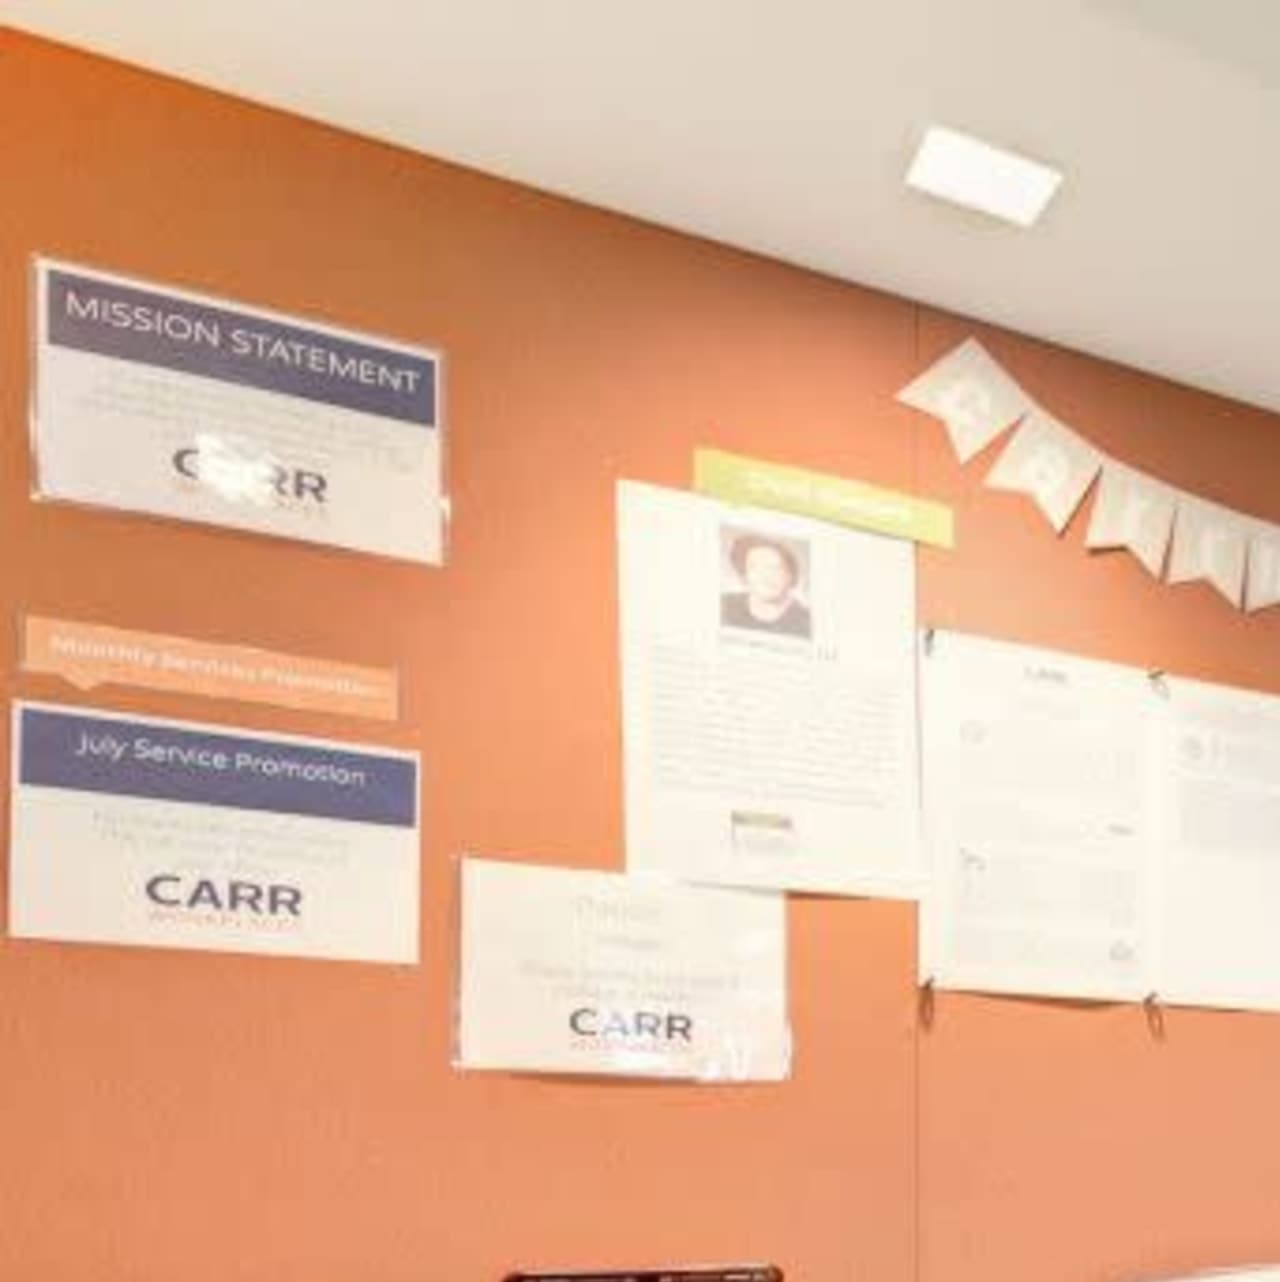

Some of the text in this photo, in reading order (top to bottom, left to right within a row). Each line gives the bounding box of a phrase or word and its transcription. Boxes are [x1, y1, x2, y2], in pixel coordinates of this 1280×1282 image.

[65, 291, 420, 394] MISSION STATEMENT
[76, 733, 366, 787] July Service Promotion
[145, 874, 302, 917] CARR
[569, 1007, 692, 1042] CARR
